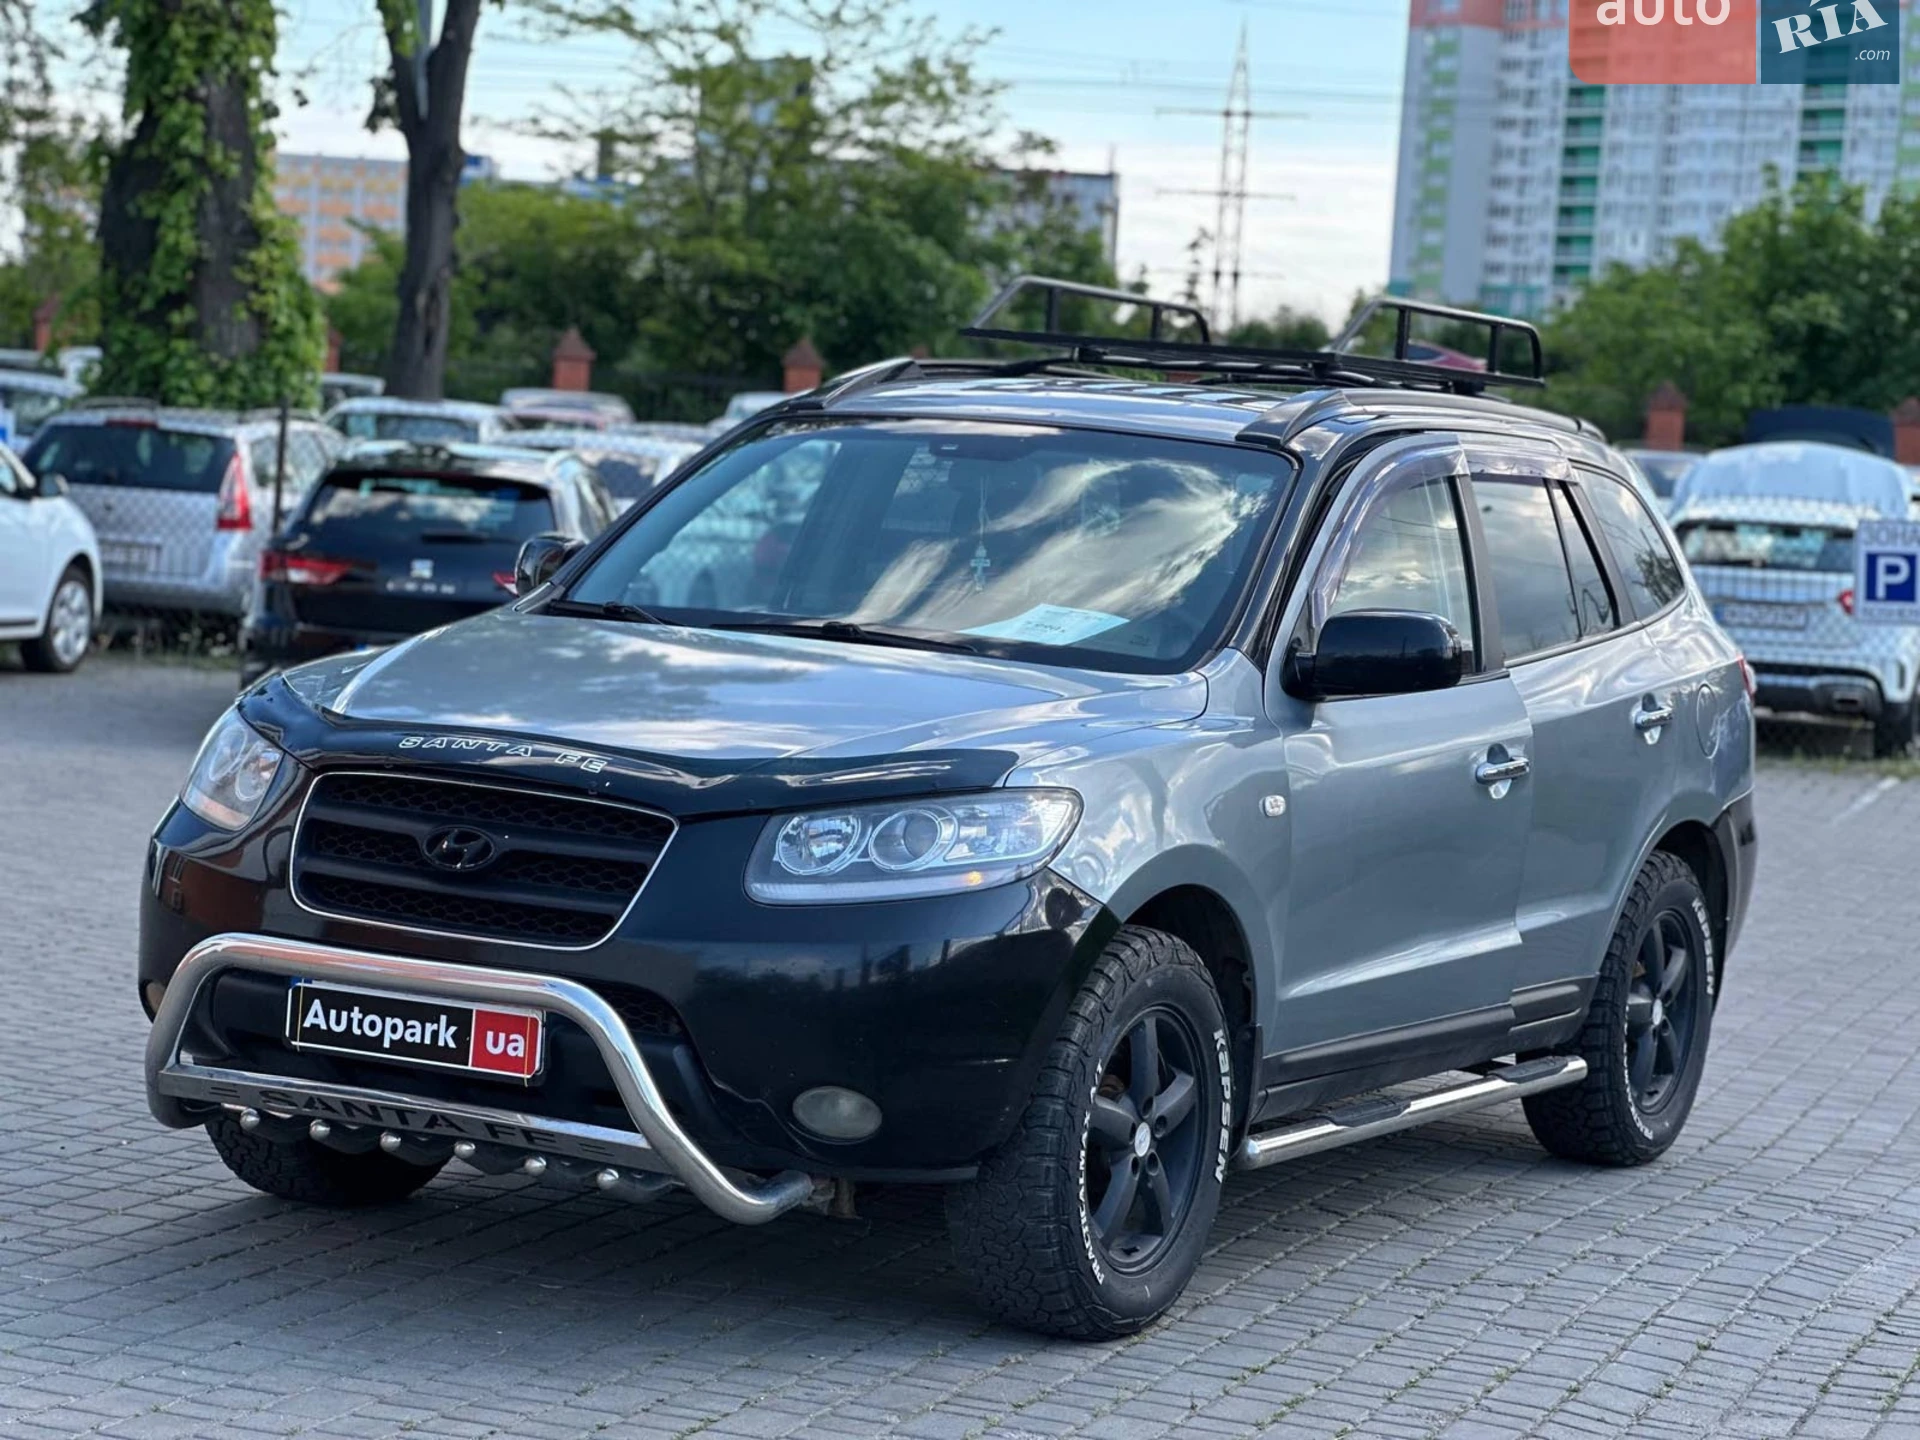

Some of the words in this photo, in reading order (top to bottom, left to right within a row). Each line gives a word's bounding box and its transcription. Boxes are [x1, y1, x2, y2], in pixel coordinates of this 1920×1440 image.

[1876, 556, 1911, 600] P
[398, 736, 533, 758] SANTA
[554, 751, 608, 774] FE
[302, 998, 458, 1049] Autopark
[485, 1029, 526, 1058] ua
[259, 1089, 466, 1134] SANTA
[482, 1122, 557, 1148] FE
[1078, 1110, 1105, 1285] PRACTICALMAX
